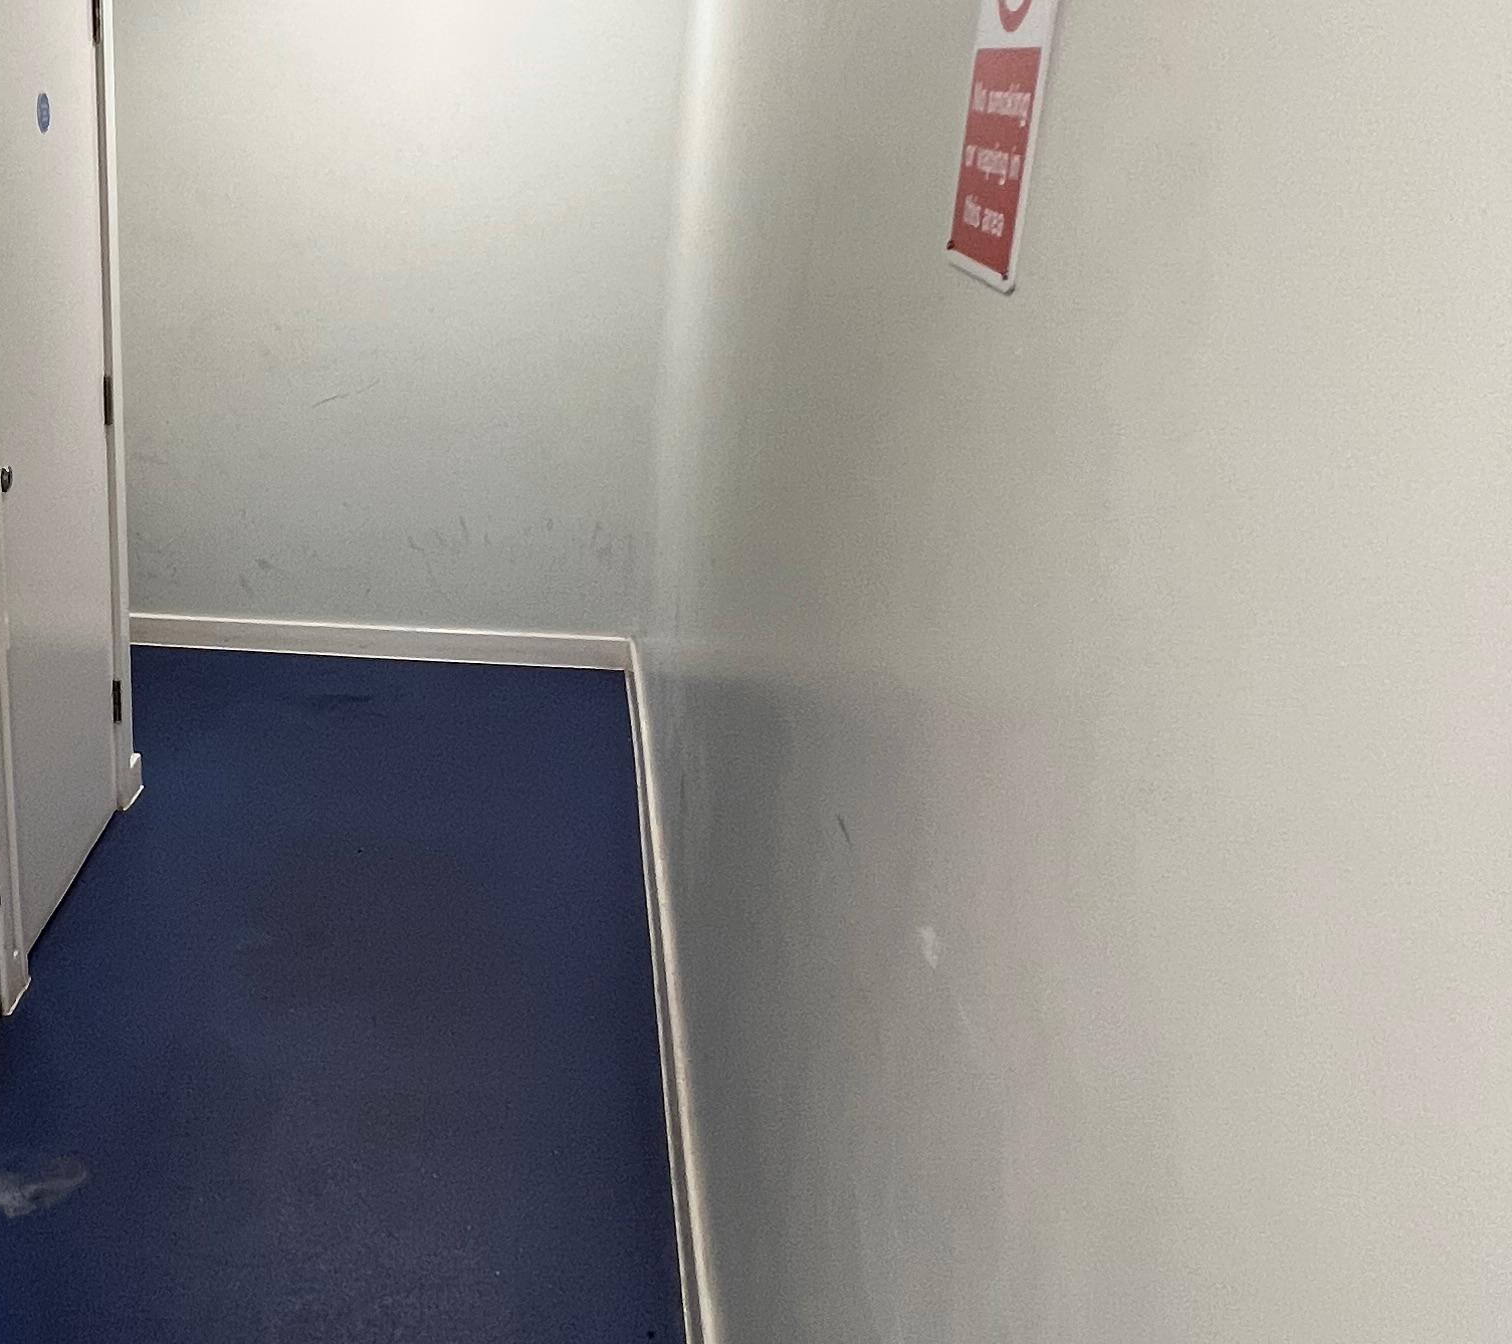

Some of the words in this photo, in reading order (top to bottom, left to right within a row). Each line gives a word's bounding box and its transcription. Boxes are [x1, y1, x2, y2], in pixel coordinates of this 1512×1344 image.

[973, 80, 987, 112] No
[987, 83, 1032, 127] smoking
[965, 144, 977, 167] or
[977, 141, 1008, 186] vaping
[963, 194, 982, 228] this
[981, 207, 1005, 237] area
